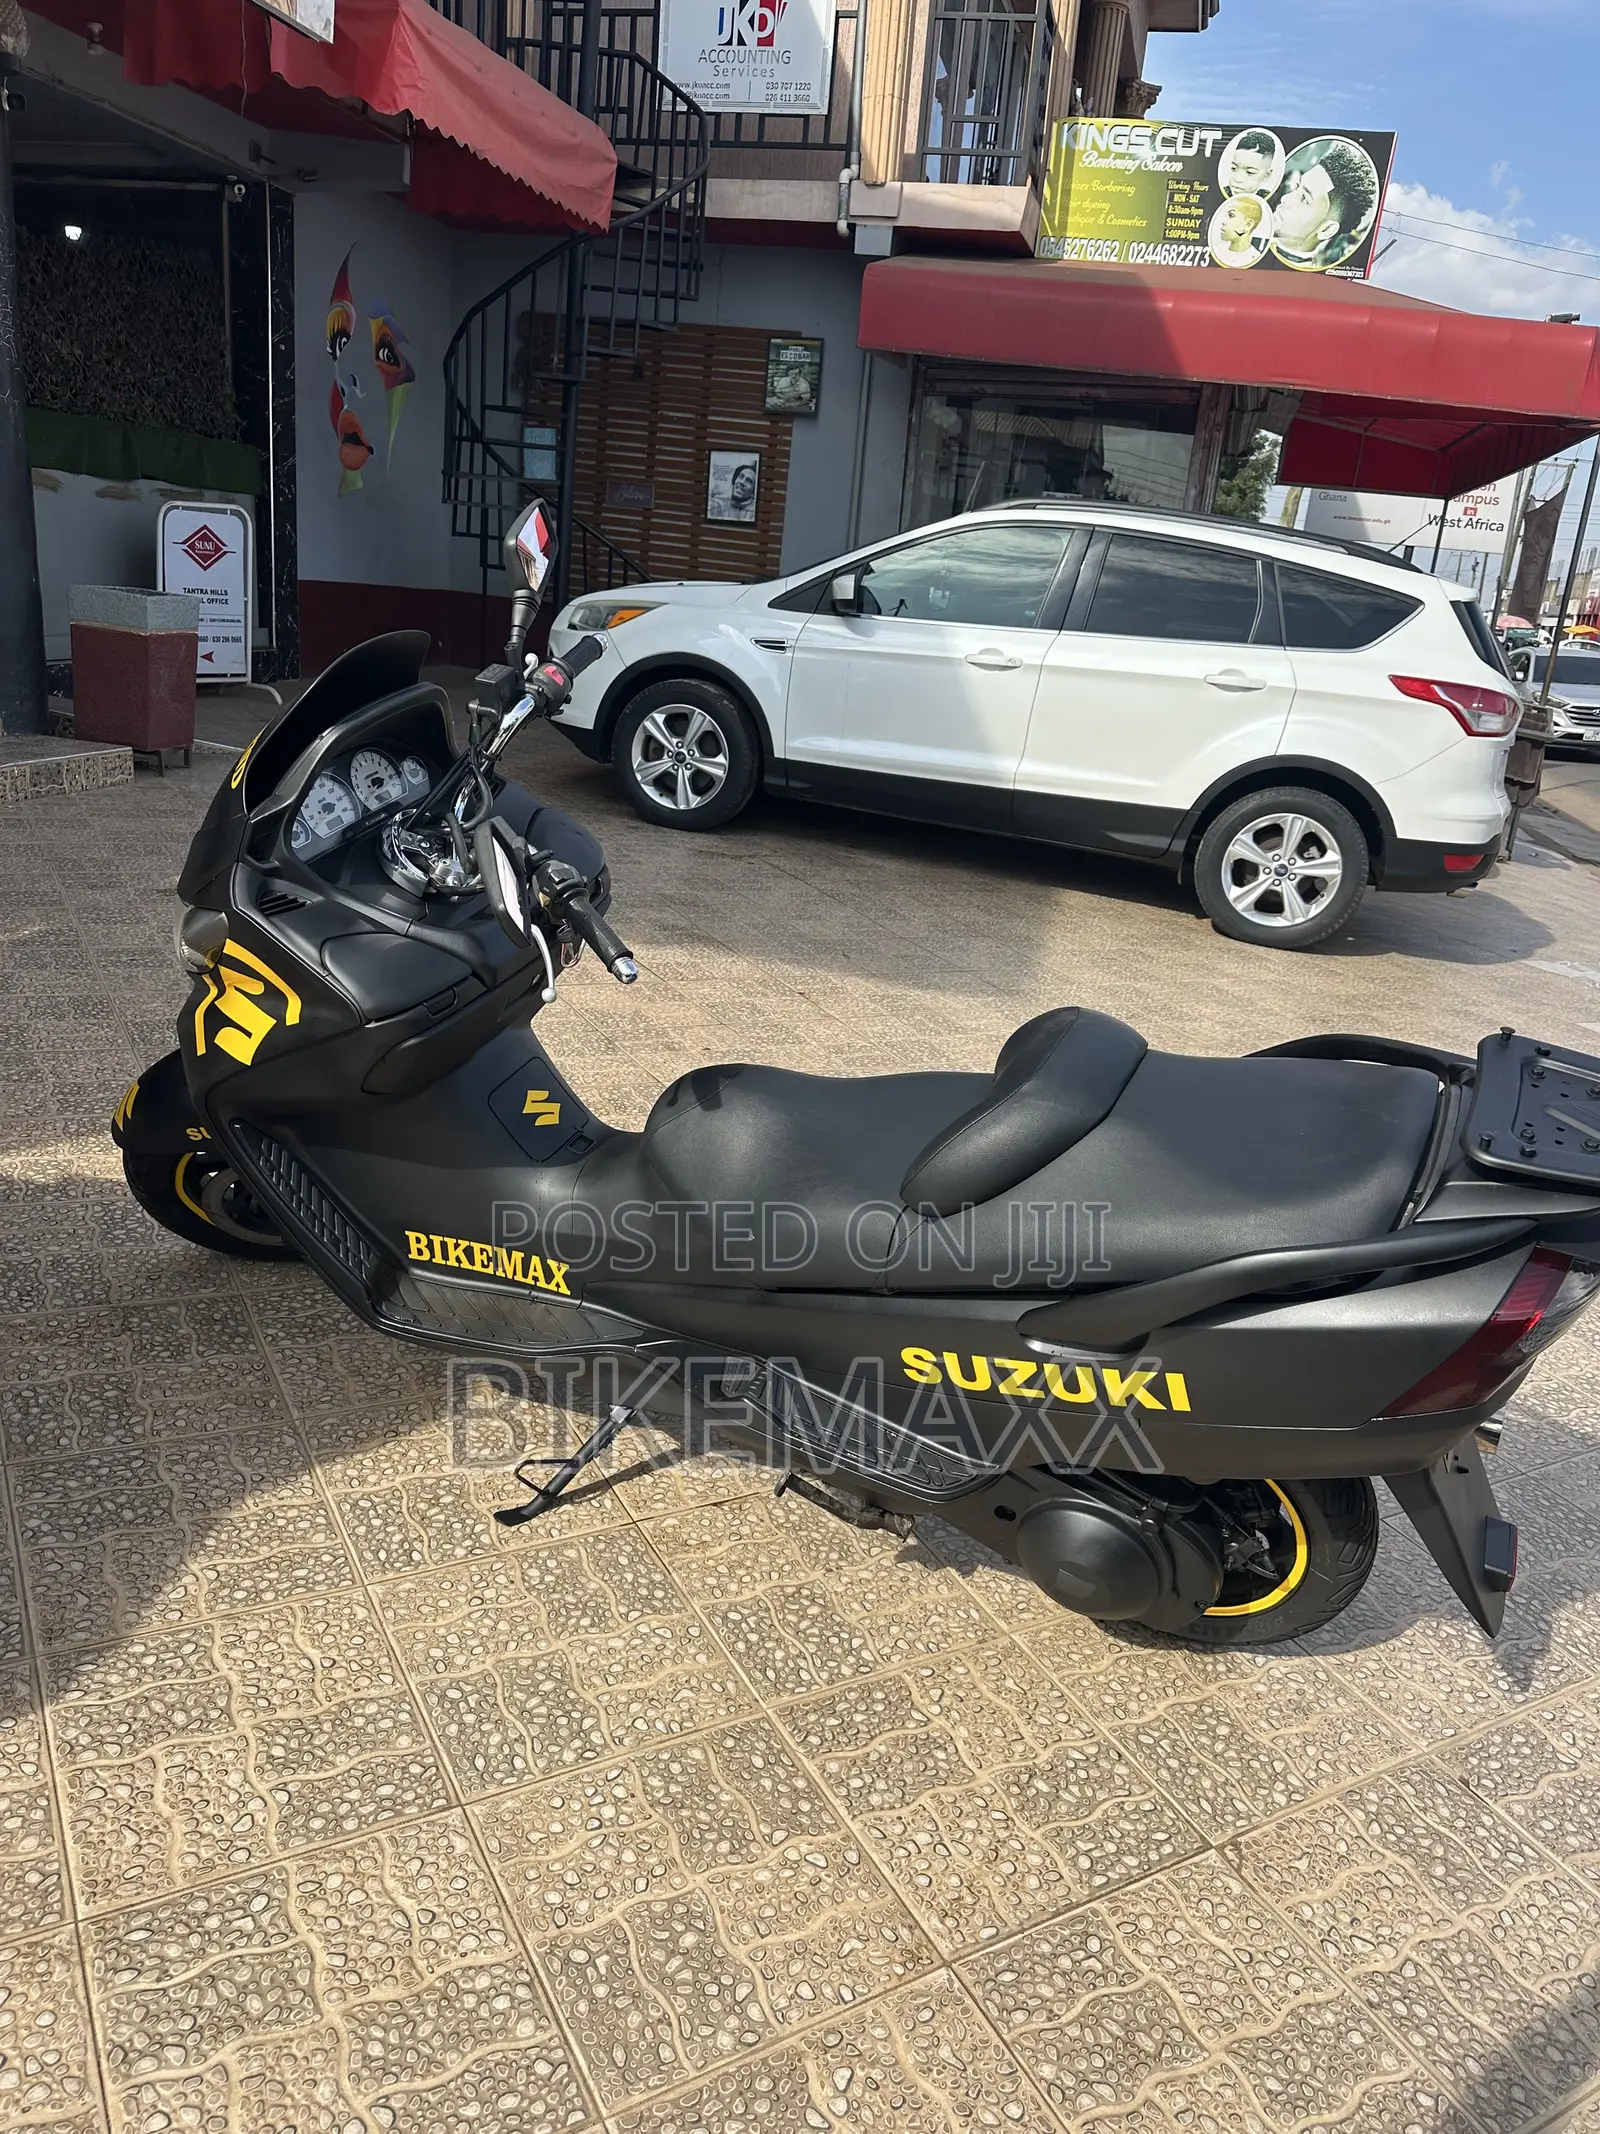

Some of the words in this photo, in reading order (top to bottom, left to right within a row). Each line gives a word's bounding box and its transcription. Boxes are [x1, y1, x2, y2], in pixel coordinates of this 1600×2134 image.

[698, 49, 792, 64] ACCOUNTING
[713, 64, 775, 78] Services
[765, 81, 779, 90] 030
[780, 82, 793, 90] 707
[794, 82, 812, 91] 1220
[779, 94, 792, 102] 411
[1060, 122, 1152, 154] KINGS
[1154, 126, 1223, 158] CUT
[1079, 150, 1141, 174] Barbering
[1140, 153, 1183, 173] Saloon
[1063, 178, 1090, 192] Unisex
[1091, 179, 1136, 197] Barbering
[1168, 180, 1191, 193] Working
[1192, 181, 1210, 191] Hours
[1082, 198, 1111, 213] dyeing
[1097, 214, 1105, 225] &
[1106, 214, 1148, 227] Cosmetics
[1165, 217, 1202, 228] SUNDAY
[1040, 236, 1120, 261] 0545276262
[1128, 241, 1211, 267] 0244682273
[780, 350, 811, 362] ESCOBAR
[1318, 490, 1348, 503] Ghana
[1453, 493, 1500, 507] ampus
[1466, 507, 1475, 516] in
[1428, 513, 1462, 529] West
[1463, 517, 1505, 532] Africa
[194, 539, 216, 551] SUNU
[182, 587, 209, 596] TANTRA
[209, 588, 229, 597] HILLS
[206, 597, 229, 605] OFFICE
[212, 635, 222, 644] 030
[405, 1230, 571, 1296] BIKEMAX
[900, 1346, 1191, 1412] SUZUKI
